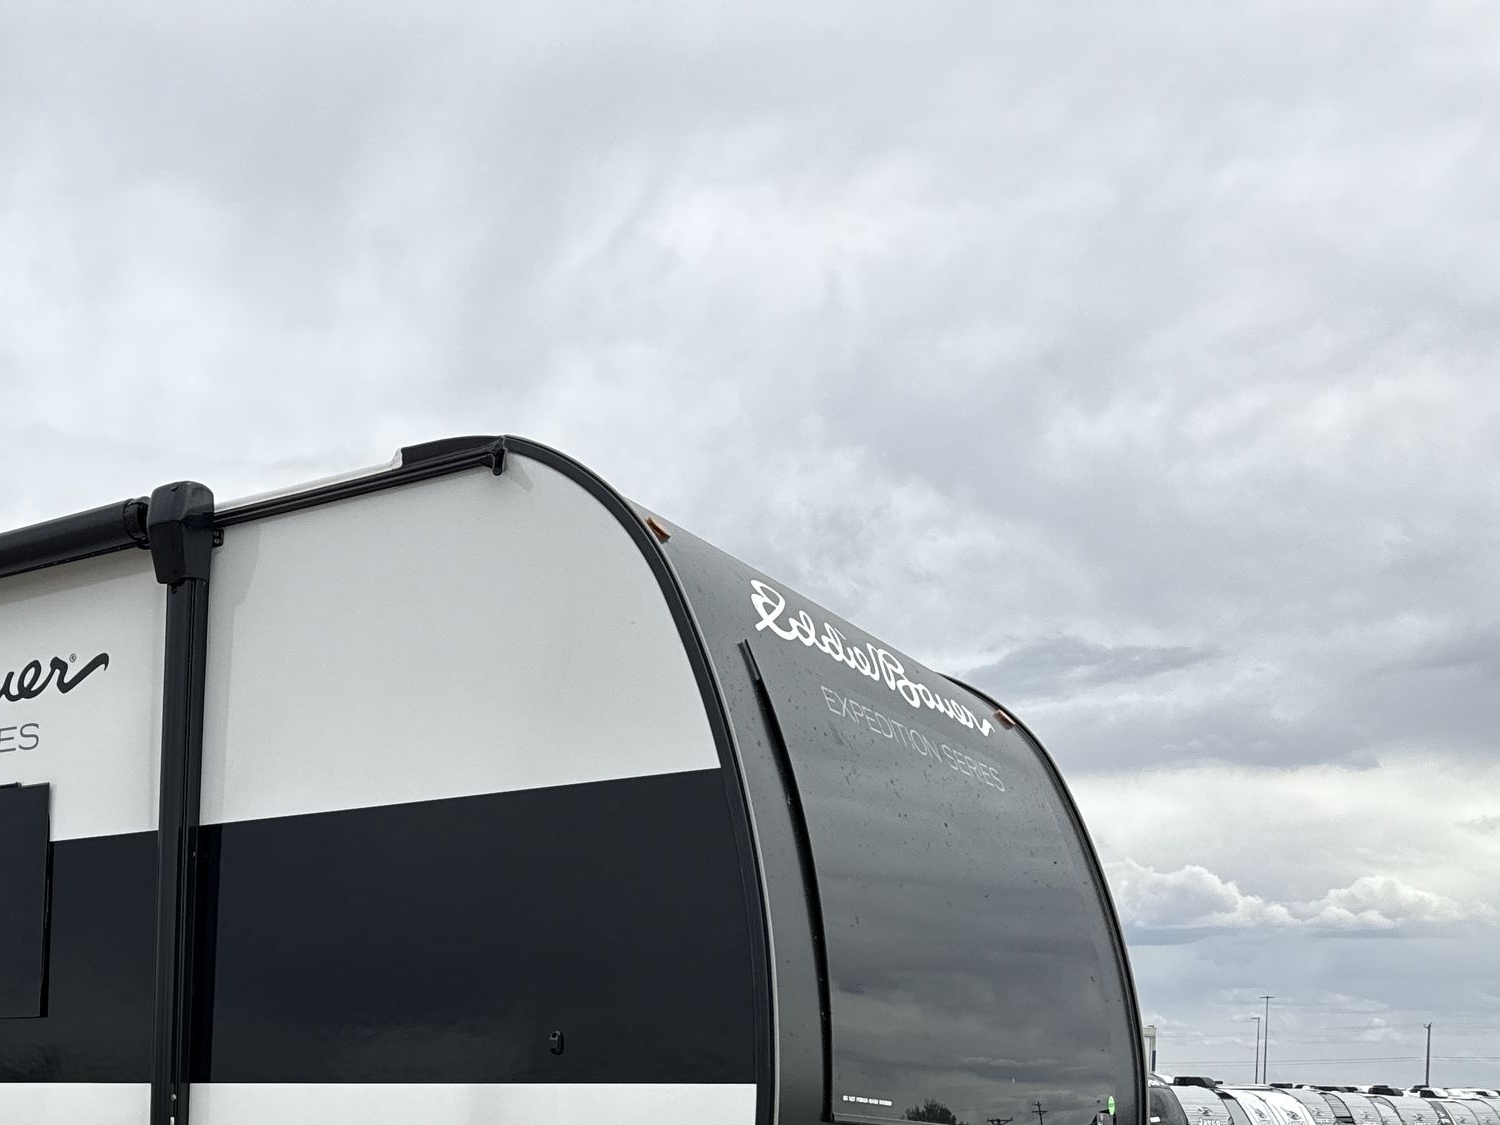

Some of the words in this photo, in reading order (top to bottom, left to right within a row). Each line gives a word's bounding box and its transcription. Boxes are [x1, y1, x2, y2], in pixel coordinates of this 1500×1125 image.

[750, 579, 872, 677] Eddie
[866, 642, 996, 737] Bauer
[820, 685, 943, 763] EXPEDITION
[941, 744, 1005, 793] SERIES
